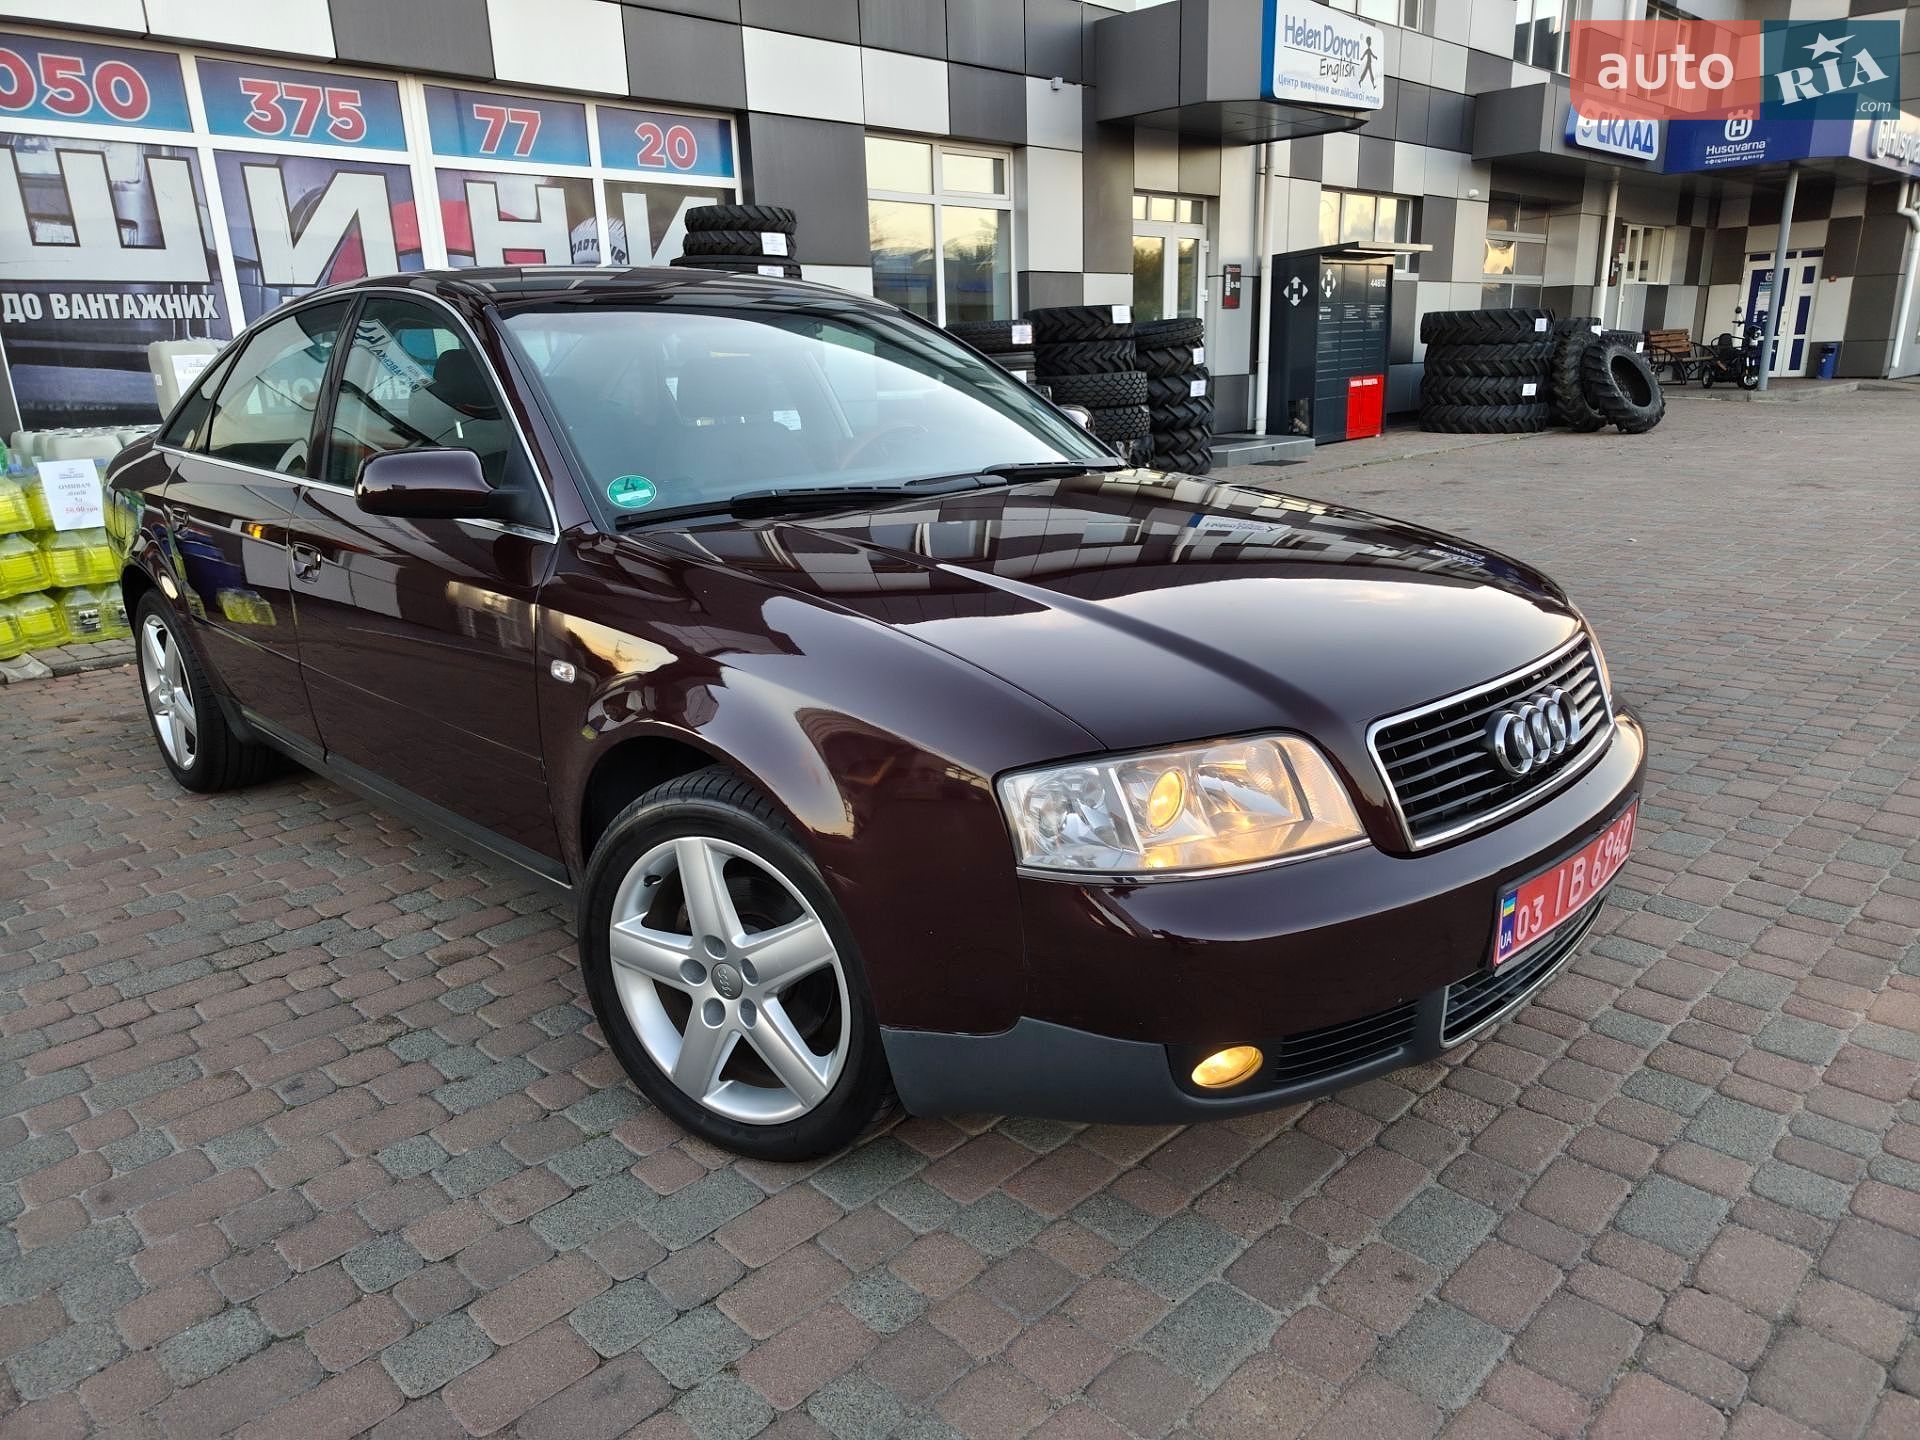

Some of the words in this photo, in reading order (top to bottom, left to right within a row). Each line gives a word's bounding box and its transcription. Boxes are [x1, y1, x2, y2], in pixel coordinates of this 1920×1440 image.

[1284, 14, 1321, 50] Helen
[1323, 24, 1360, 60] Doron
[1278, 74, 1299, 89] Центр
[1319, 57, 1356, 83] English
[0, 48, 151, 122] 050
[239, 77, 367, 143] 375
[473, 104, 541, 157] 77
[634, 122, 698, 170] 20
[1596, 112, 1654, 154] СКЛАД
[1705, 140, 1766, 155] Husqvarna
[2, 293, 44, 323] ДО
[50, 293, 221, 322] ВАНТАЖНИХ
[1516, 895, 1545, 941] 03
[1590, 813, 1632, 888] 6942
[1500, 933, 1512, 949] UA
